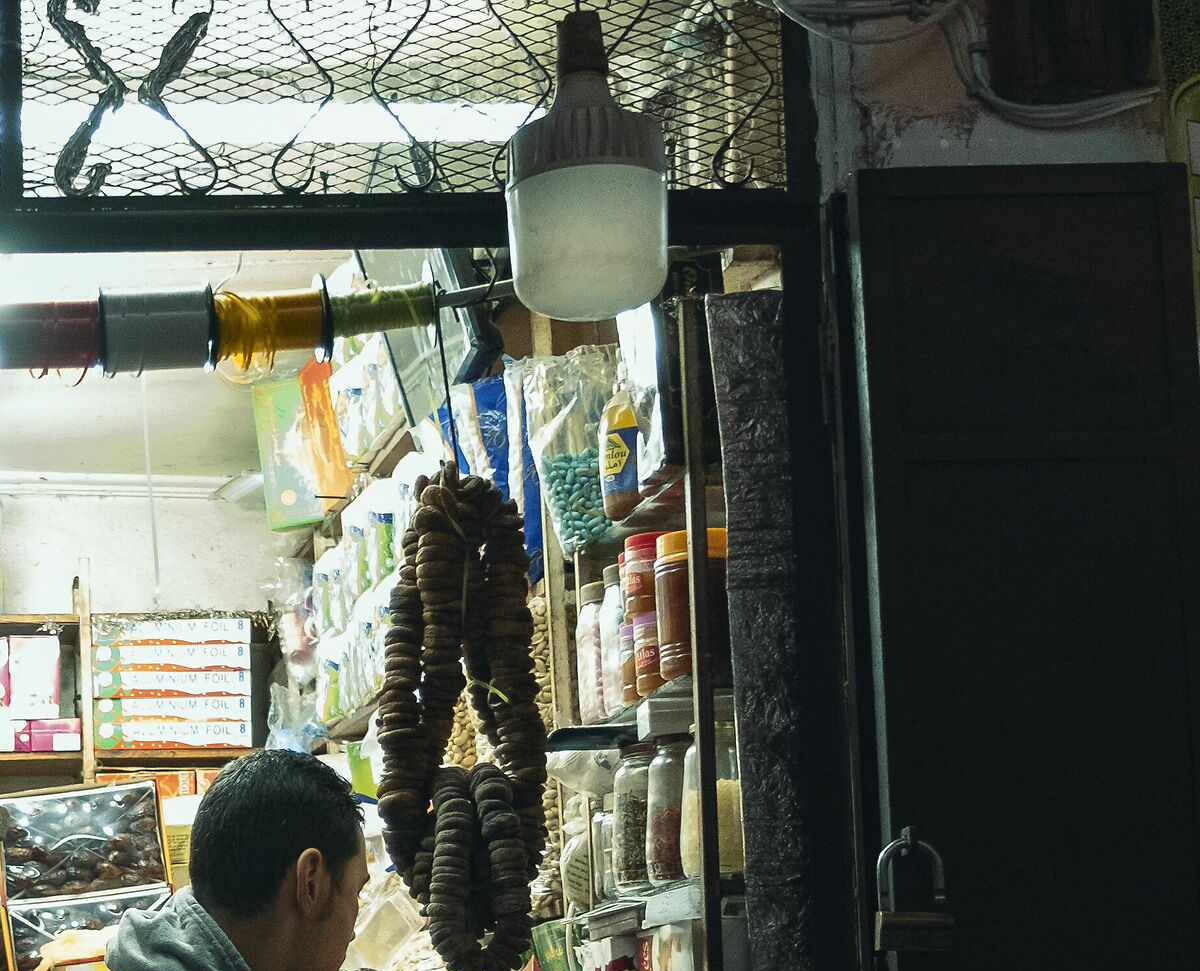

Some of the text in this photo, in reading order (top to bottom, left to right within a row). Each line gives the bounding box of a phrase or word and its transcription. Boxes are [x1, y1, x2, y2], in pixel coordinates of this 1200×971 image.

[203, 621, 229, 631] FOIL
[237, 620, 244, 630] 8
[237, 646, 244, 657] 8
[204, 674, 230, 684] FOIL
[238, 671, 245, 682] 8
[204, 699, 231, 710] FOIL
[239, 698, 246, 709] 8
[206, 725, 232, 736] FOIL
[239, 723, 247, 734] 8
